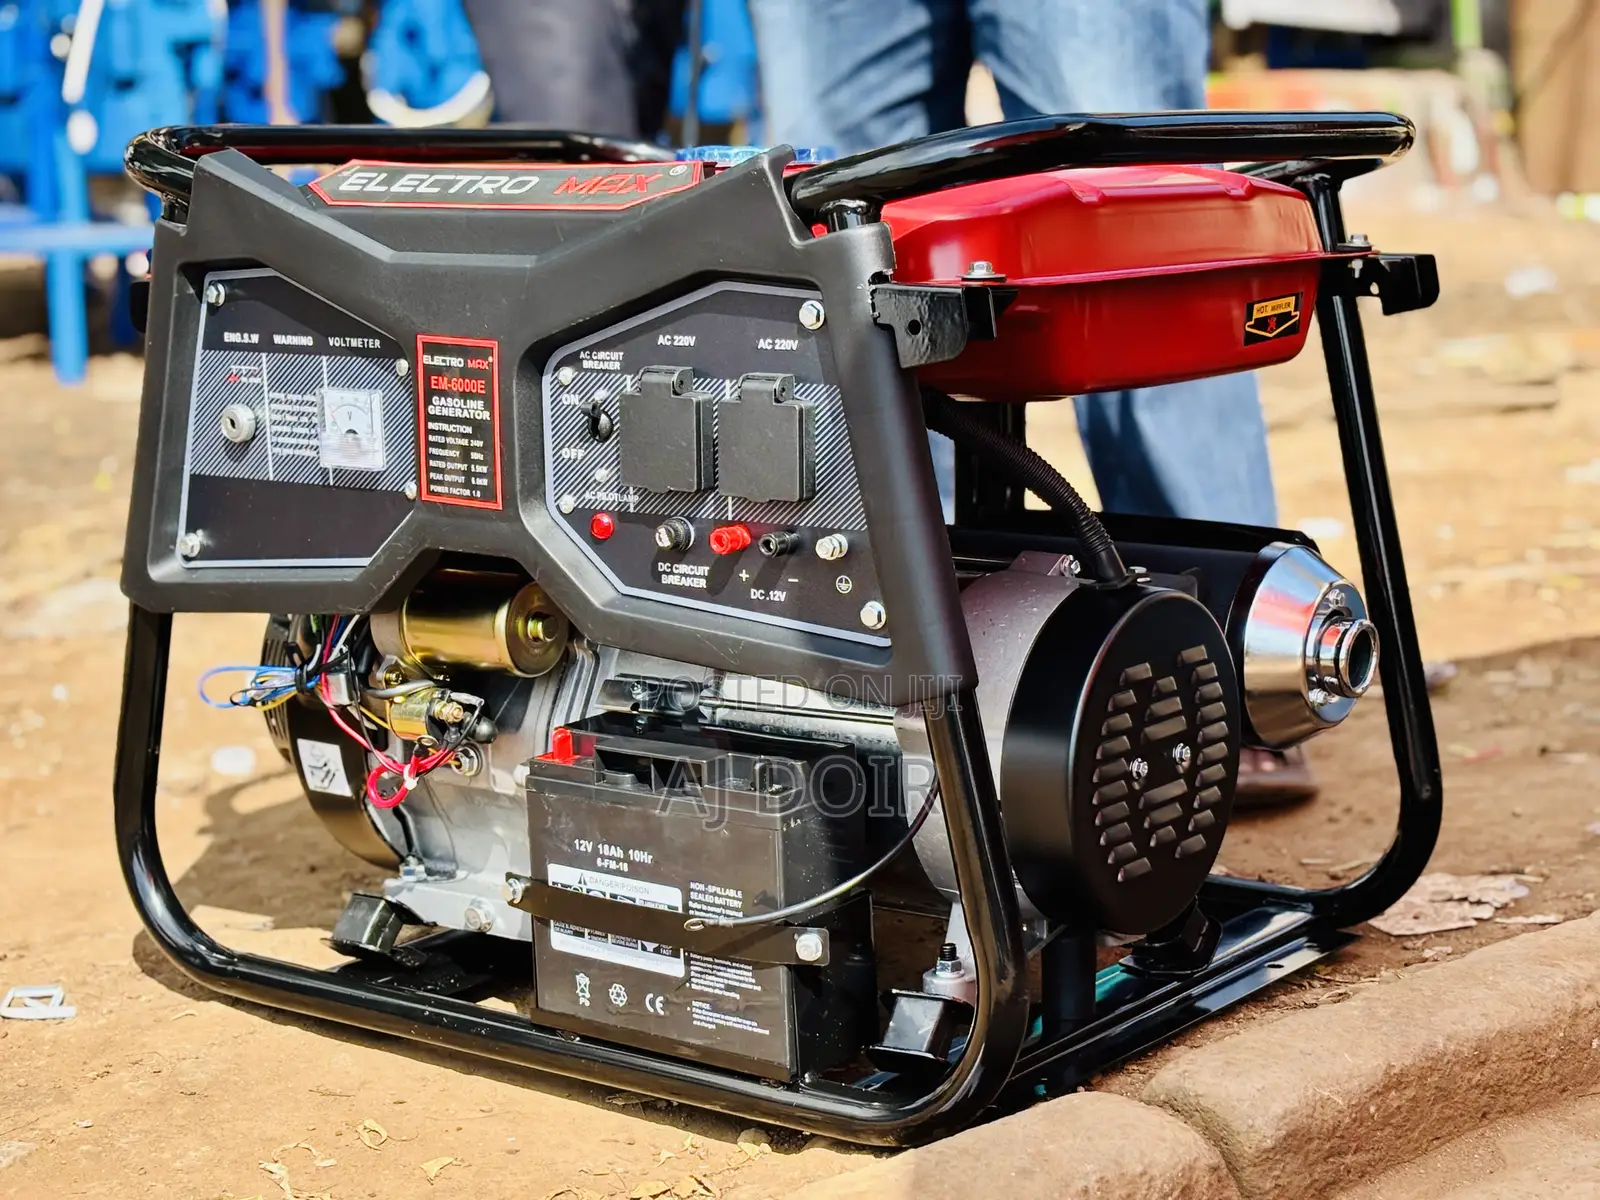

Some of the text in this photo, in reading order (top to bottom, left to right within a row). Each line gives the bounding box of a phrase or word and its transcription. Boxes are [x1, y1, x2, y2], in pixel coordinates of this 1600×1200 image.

[338, 171, 541, 195] ELECTRO
[1256, 305, 1269, 314] HOT
[273, 333, 314, 346] WARNING
[328, 336, 381, 349] VOLTMETER
[657, 334, 696, 347] AC 220V
[757, 338, 799, 351] AC 220V
[422, 354, 464, 368] ELECTRO
[579, 351, 624, 361] AC CIRCUIT
[582, 359, 621, 370] BREAKER
[430, 375, 486, 394] EM-6000E
[432, 396, 485, 410] GASOLINE
[561, 393, 580, 406] ON
[427, 405, 491, 421] GENERATOR
[427, 421, 473, 434] INSTRUCTION
[428, 447, 460, 458] FREQUENCY
[561, 447, 585, 460] OFF
[446, 461, 468, 471] OUTPUT
[429, 472, 444, 481] PEAK
[444, 473, 465, 483] OUTPUT
[430, 484, 449, 493] POWER
[657, 561, 710, 576] DC CIRCUIT
[661, 573, 707, 589] BREAKER
[750, 587, 765, 600] DC
[574, 838, 654, 864] 12V 18Ah 10Hr
[596, 857, 629, 872] 6-FM-18
[690, 891, 743, 908] SEALED BATTERY
